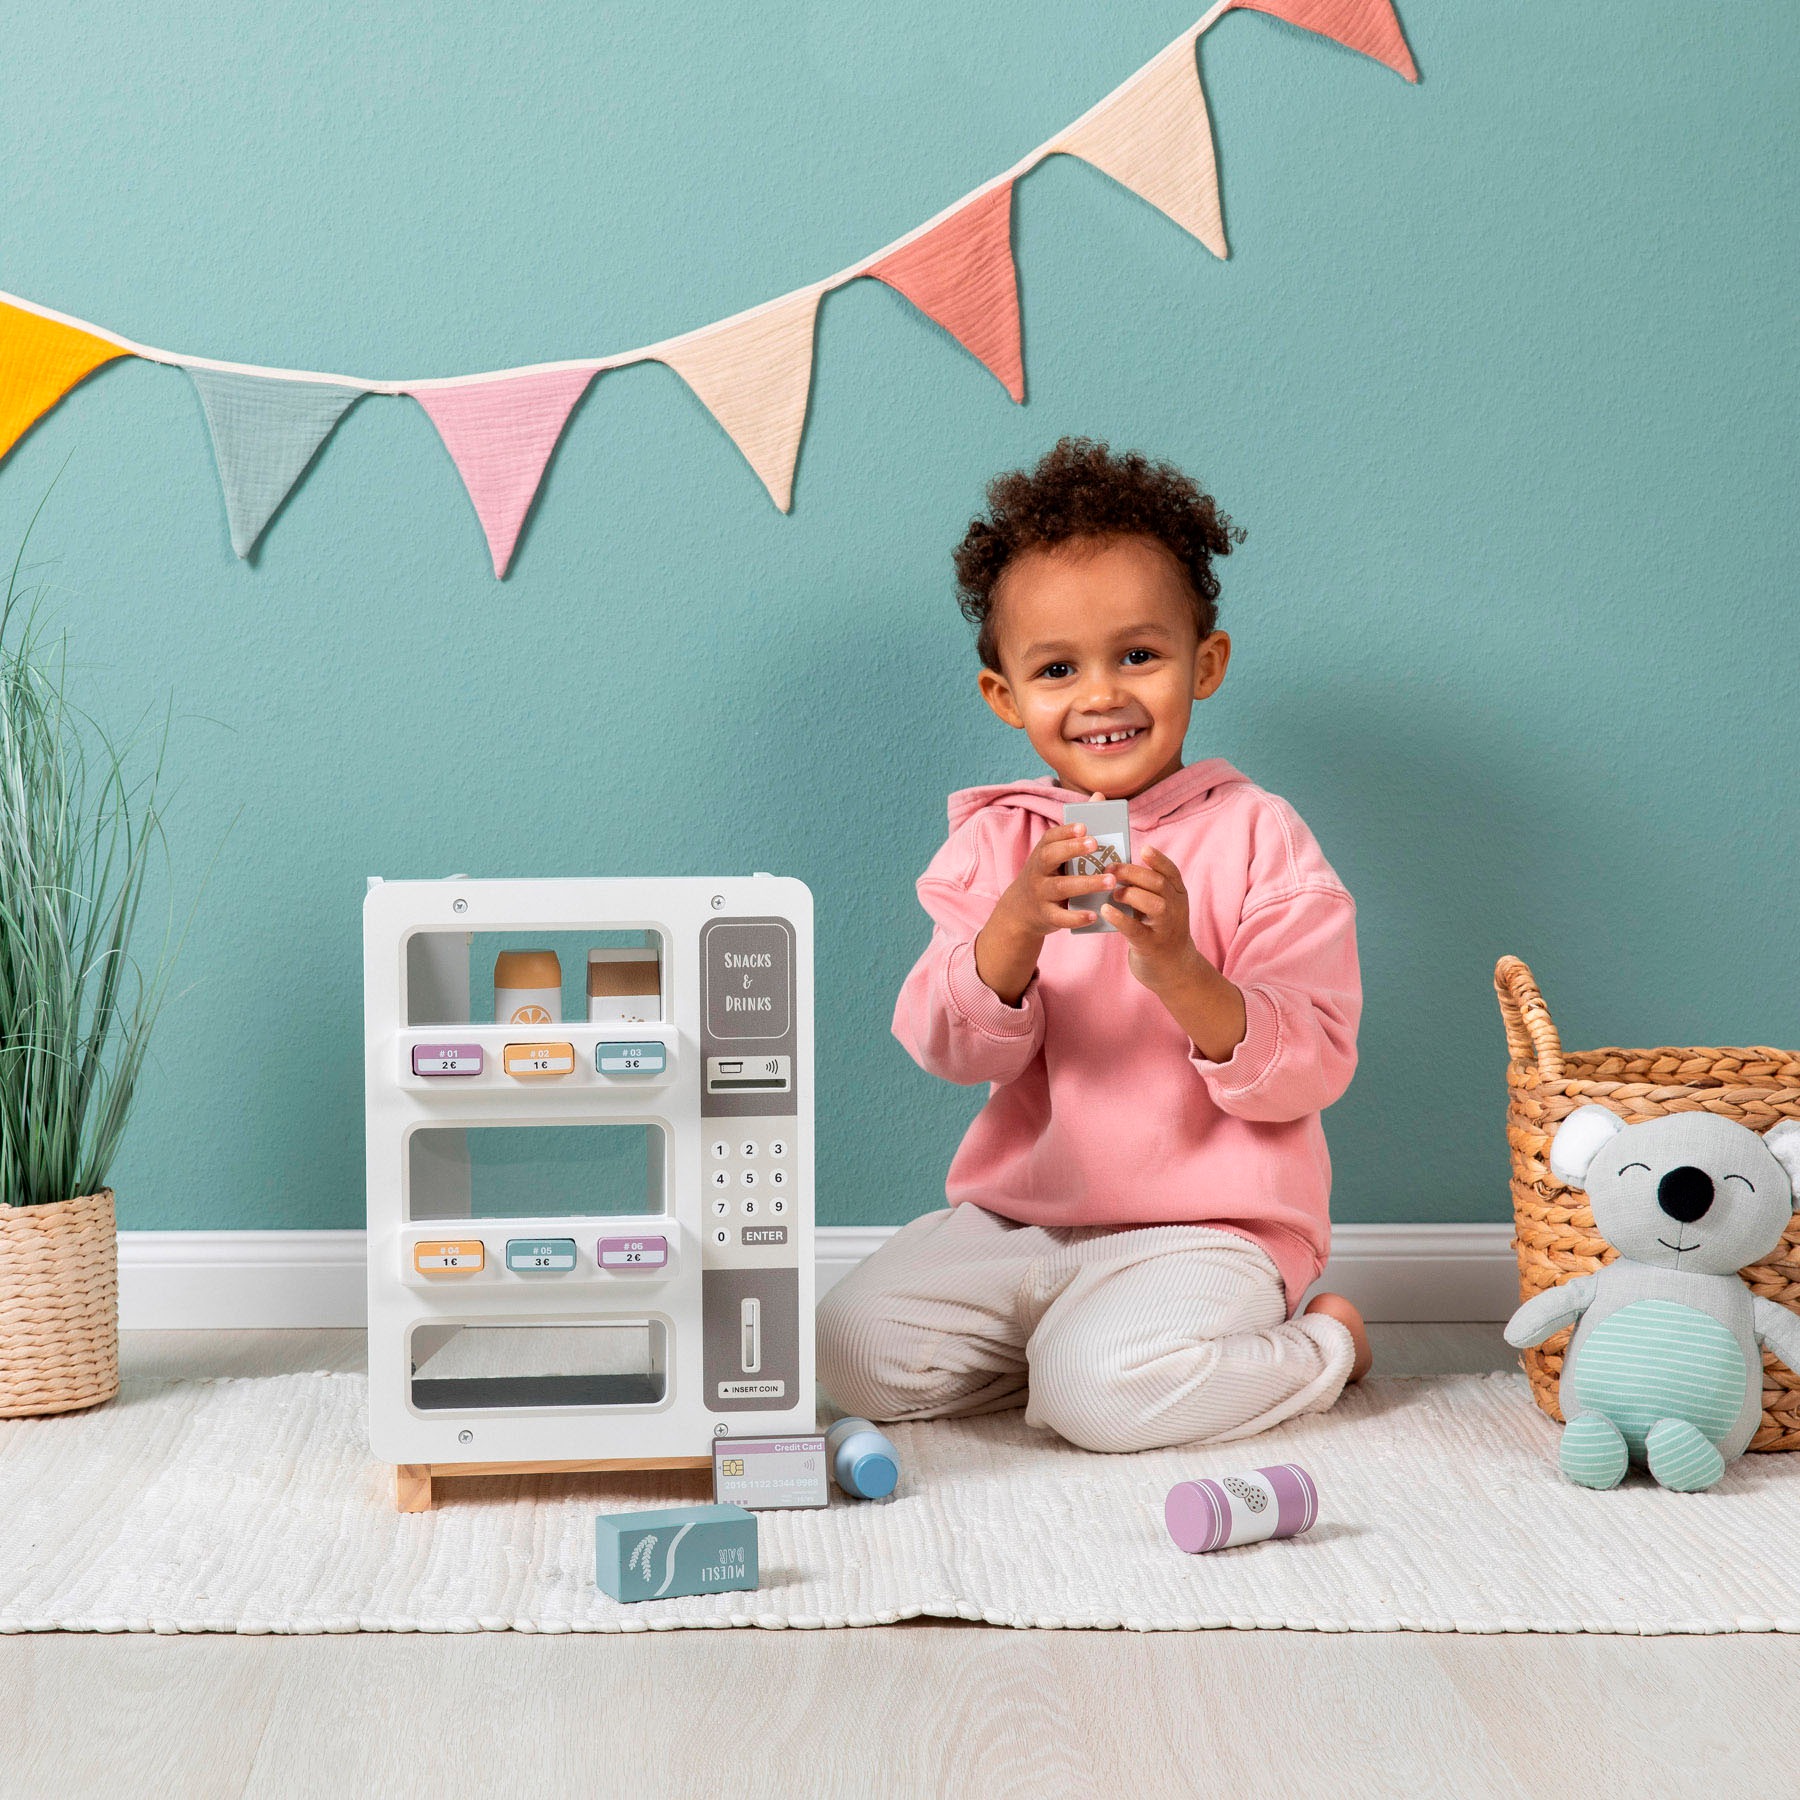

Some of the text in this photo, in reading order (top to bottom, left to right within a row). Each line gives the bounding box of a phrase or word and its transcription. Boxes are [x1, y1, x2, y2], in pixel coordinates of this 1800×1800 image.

[743, 974, 753, 990] &
[447, 1050, 459, 1058] 01
[538, 1049, 550, 1058] 02
[630, 1048, 642, 1057] 03
[442, 1061, 457, 1070] 2 €
[534, 1061, 548, 1070] 1 €
[625, 1060, 640, 1069] 3 €
[717, 1145, 723, 1156] 1
[745, 1144, 754, 1155] 2
[774, 1144, 783, 1155] 3
[716, 1174, 725, 1185] 4
[746, 1173, 754, 1184] 5
[774, 1172, 783, 1183] 6
[717, 1203, 726, 1214] 7
[746, 1202, 754, 1213] 8
[775, 1201, 784, 1212] 9
[717, 1231, 726, 1242] 0
[746, 1230, 784, 1241] ENTER
[540, 1246, 552, 1255] 05
[631, 1242, 644, 1251] 06
[443, 1258, 458, 1267] 1 €
[535, 1258, 550, 1267] 3 €
[626, 1253, 642, 1262] 2 €
[758, 1385, 779, 1393] COIN
[774, 1442, 822, 1452] Credit Card
[718, 1546, 745, 1565] BAR
[701, 1564, 745, 1582] MUESLI
